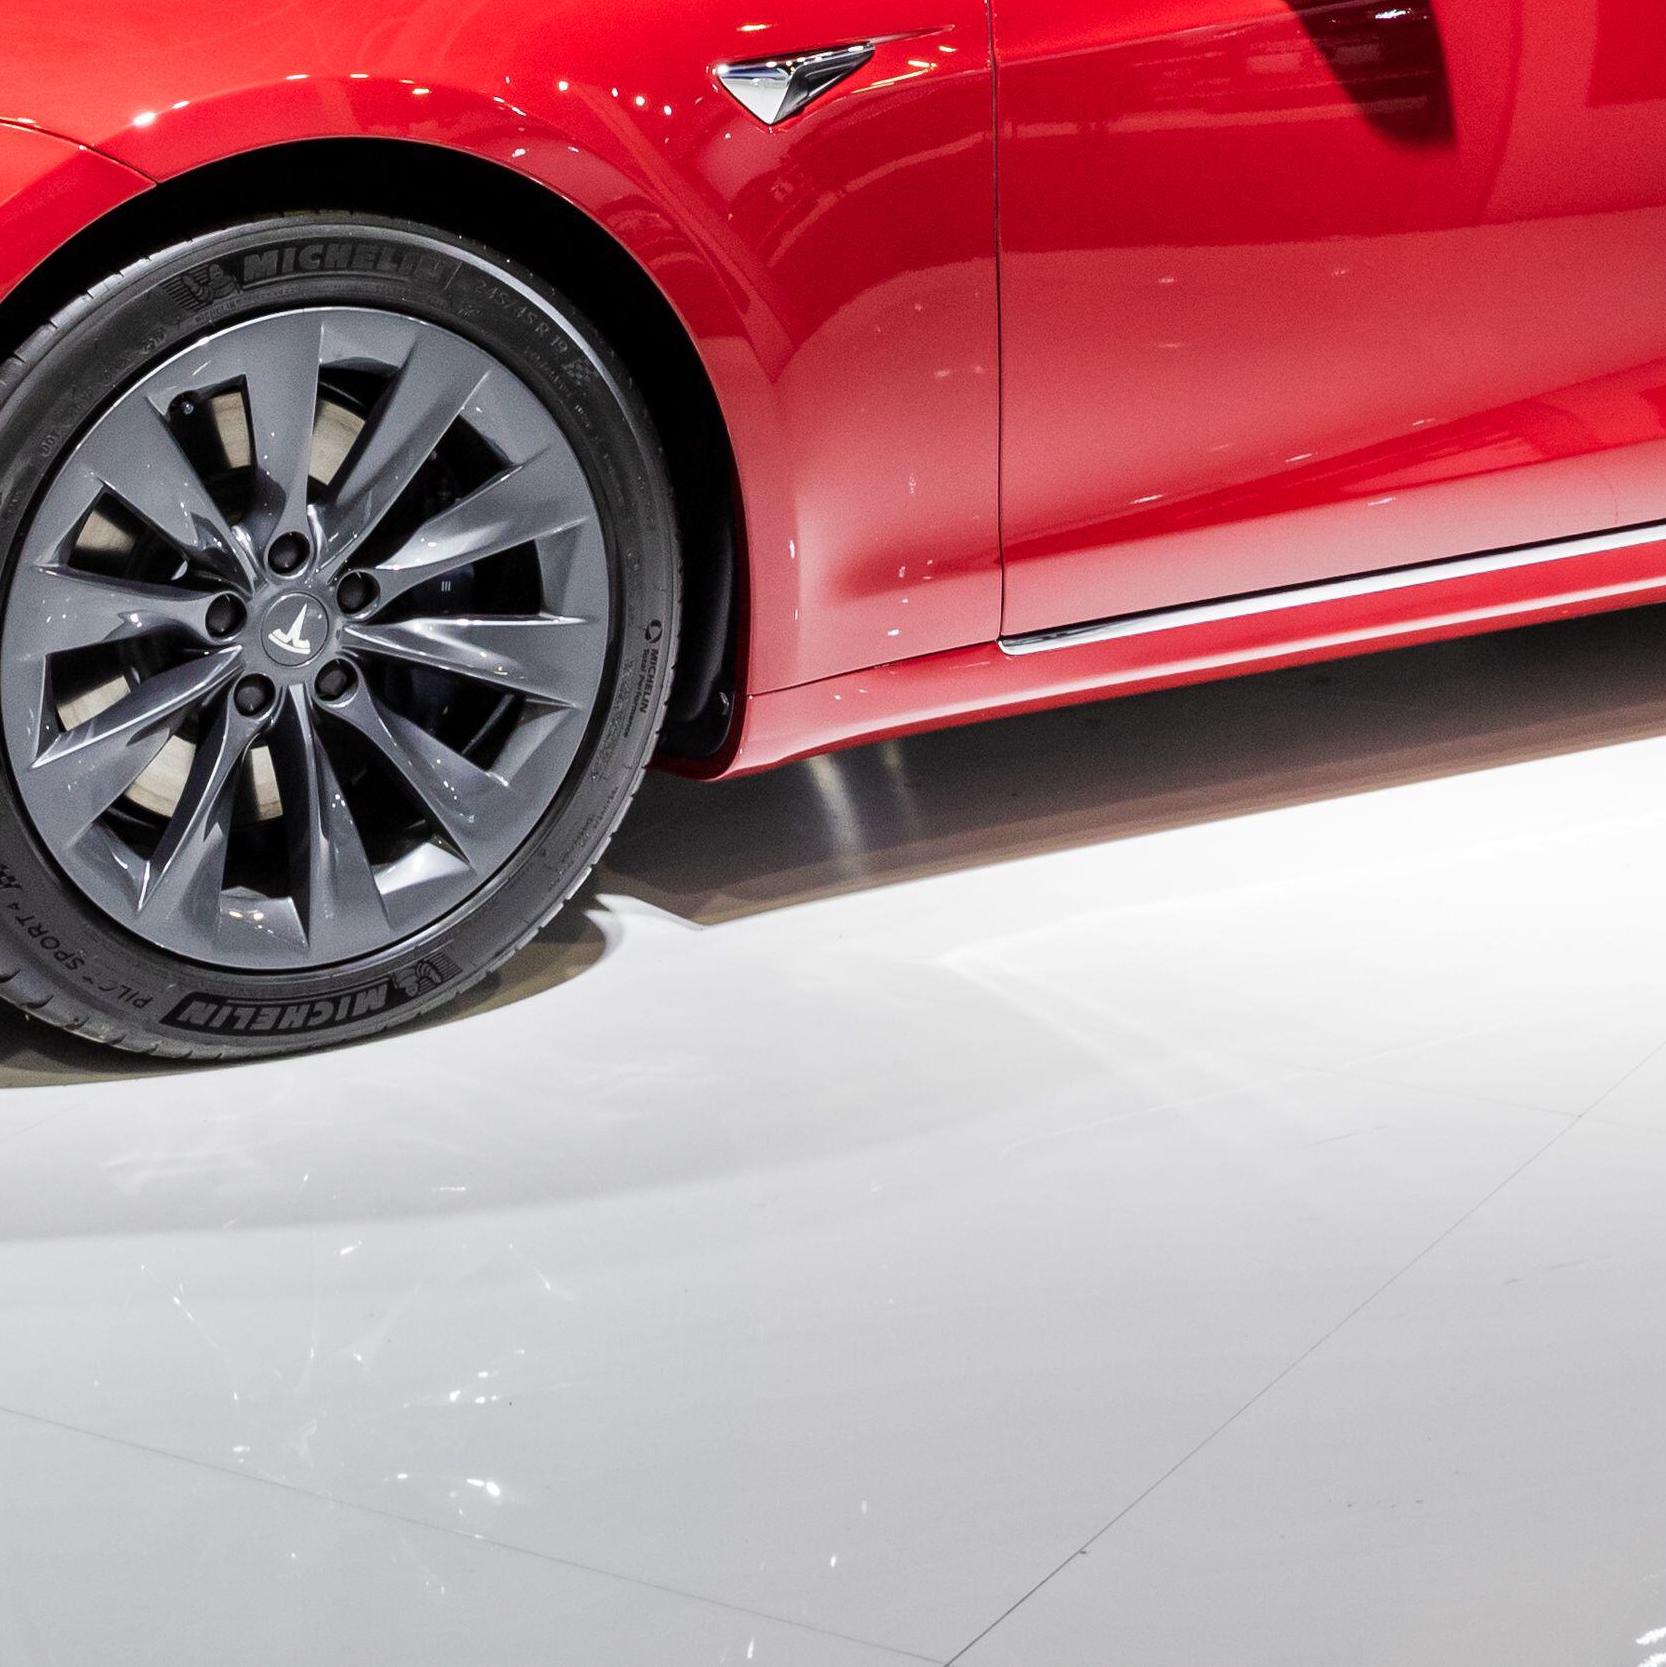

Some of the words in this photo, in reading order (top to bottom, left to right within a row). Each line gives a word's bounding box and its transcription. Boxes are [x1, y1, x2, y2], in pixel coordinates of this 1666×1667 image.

[242, 243, 447, 282] MICHELIN
[639, 647, 650, 672] Total
[639, 647, 659, 714] MICHELIN
[623, 674, 646, 739] Performance
[14, 914, 85, 971] SPORT
[176, 982, 388, 1032] MICHELIN
